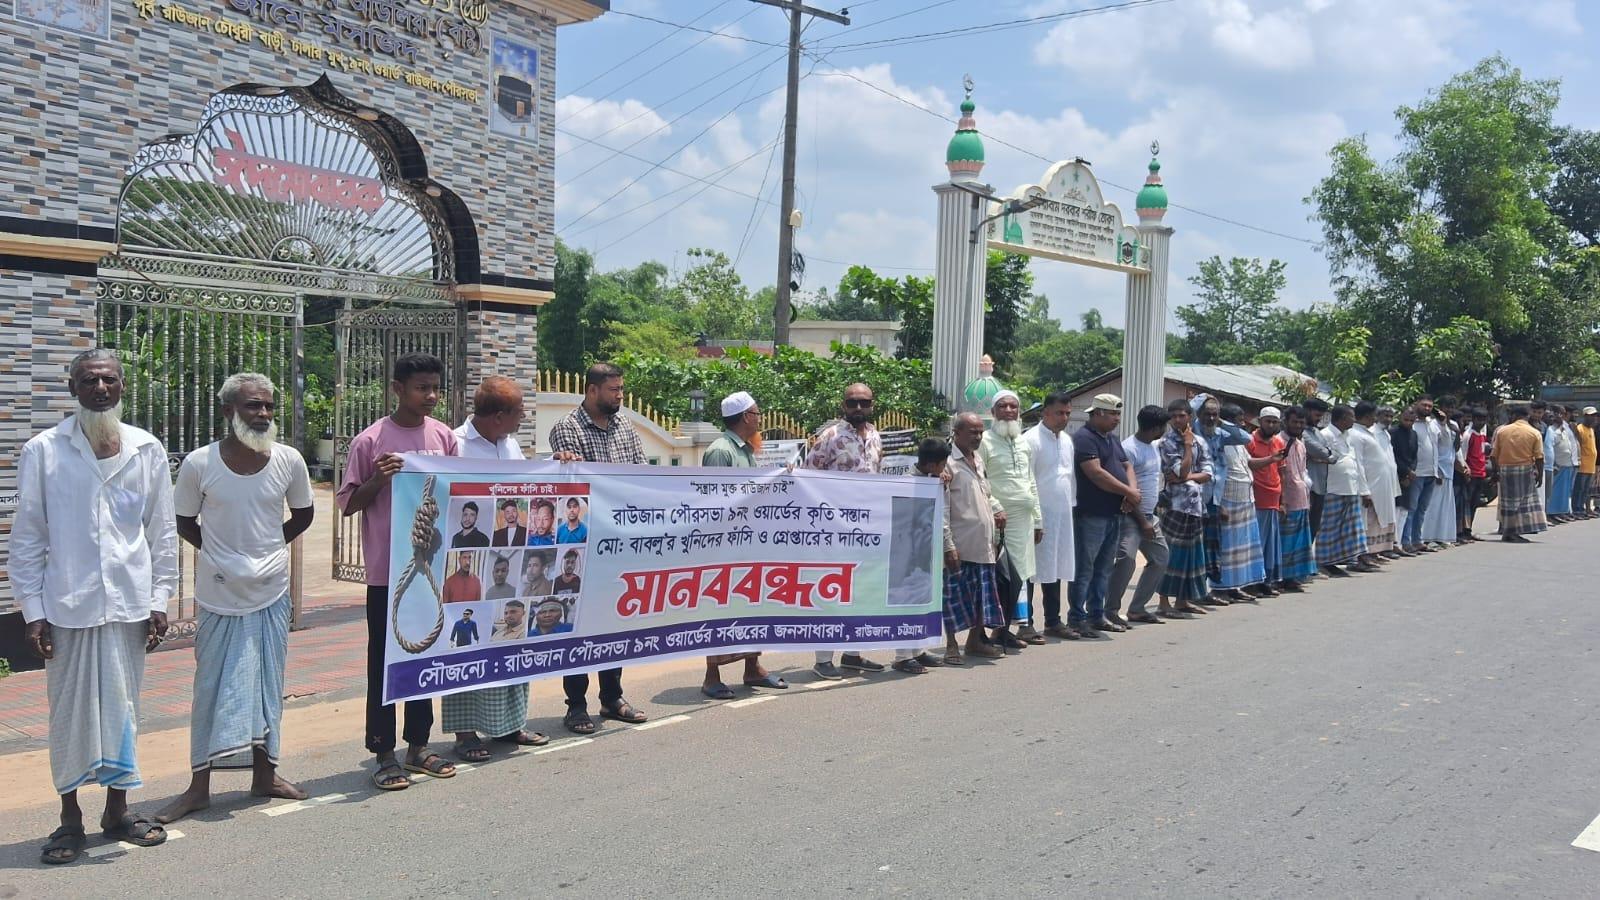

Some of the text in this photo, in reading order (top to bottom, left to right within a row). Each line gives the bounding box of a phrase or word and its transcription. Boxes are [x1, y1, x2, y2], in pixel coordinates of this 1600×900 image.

[162, 4, 212, 33] রাউজান
[404, 69, 440, 92] রাউজান
[441, 79, 479, 102] পৌরসভা
[319, 14, 418, 64] মসজিদ
[720, 482, 738, 498] মুক্ত
[739, 480, 771, 496] রাউজান
[611, 500, 872, 529] রাউজান পৌরসভা ৯নং ওয়ার্ডের কৃতি সন্তান
[680, 528, 725, 554] খুনিদের
[727, 524, 754, 547] ফাঁসি
[757, 531, 768, 545] ও
[838, 527, 882, 548] দাবিতে
[616, 562, 857, 617] মানববন্ধন
[418, 657, 489, 689] সৌজন্যে
[504, 648, 564, 673] রাউজান
[568, 638, 631, 665] পৌরসভা
[633, 635, 660, 653] ৯নং
[665, 623, 714, 648] ওয়ার্ডের
[715, 621, 771, 644] সর্বস্তরের
